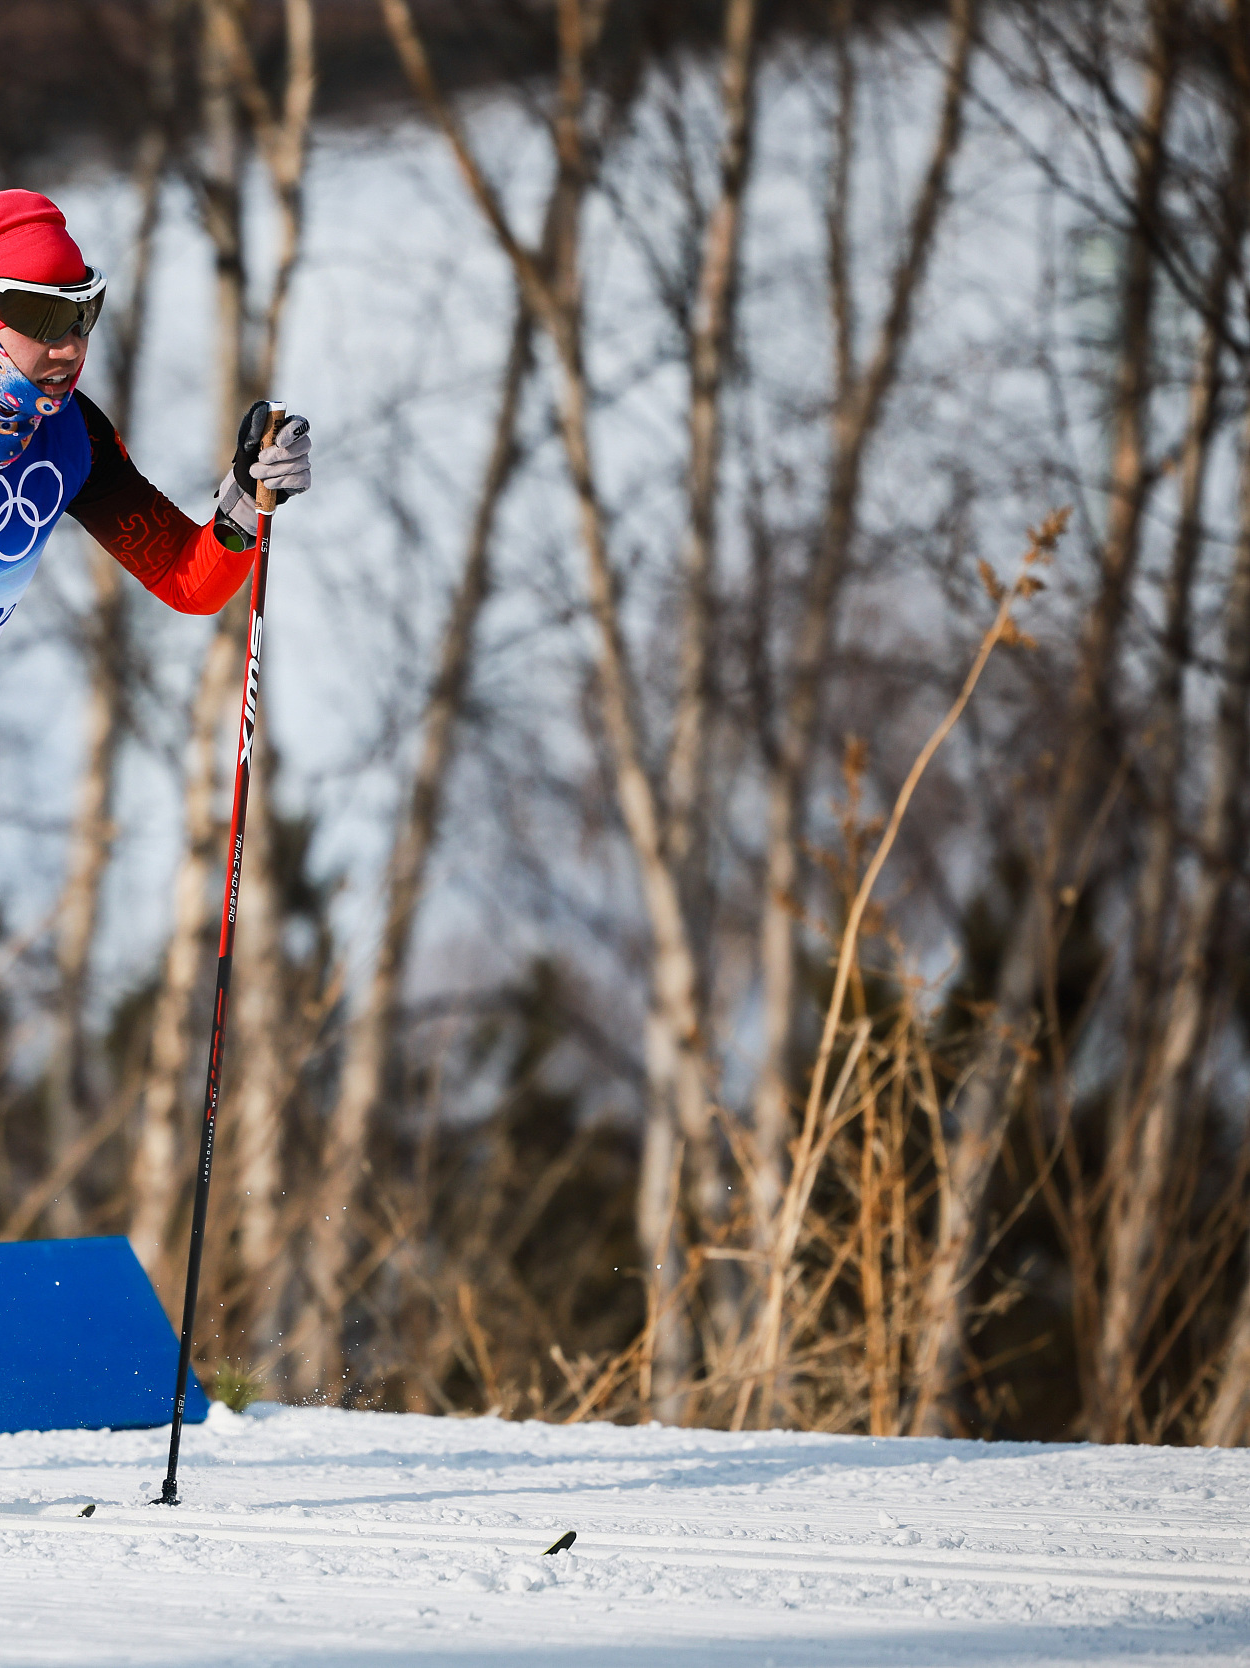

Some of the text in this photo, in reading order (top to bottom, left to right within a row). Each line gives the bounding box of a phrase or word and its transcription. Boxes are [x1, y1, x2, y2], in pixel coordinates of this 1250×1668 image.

[228, 833, 243, 923] TRIAC 4.0 AERO
